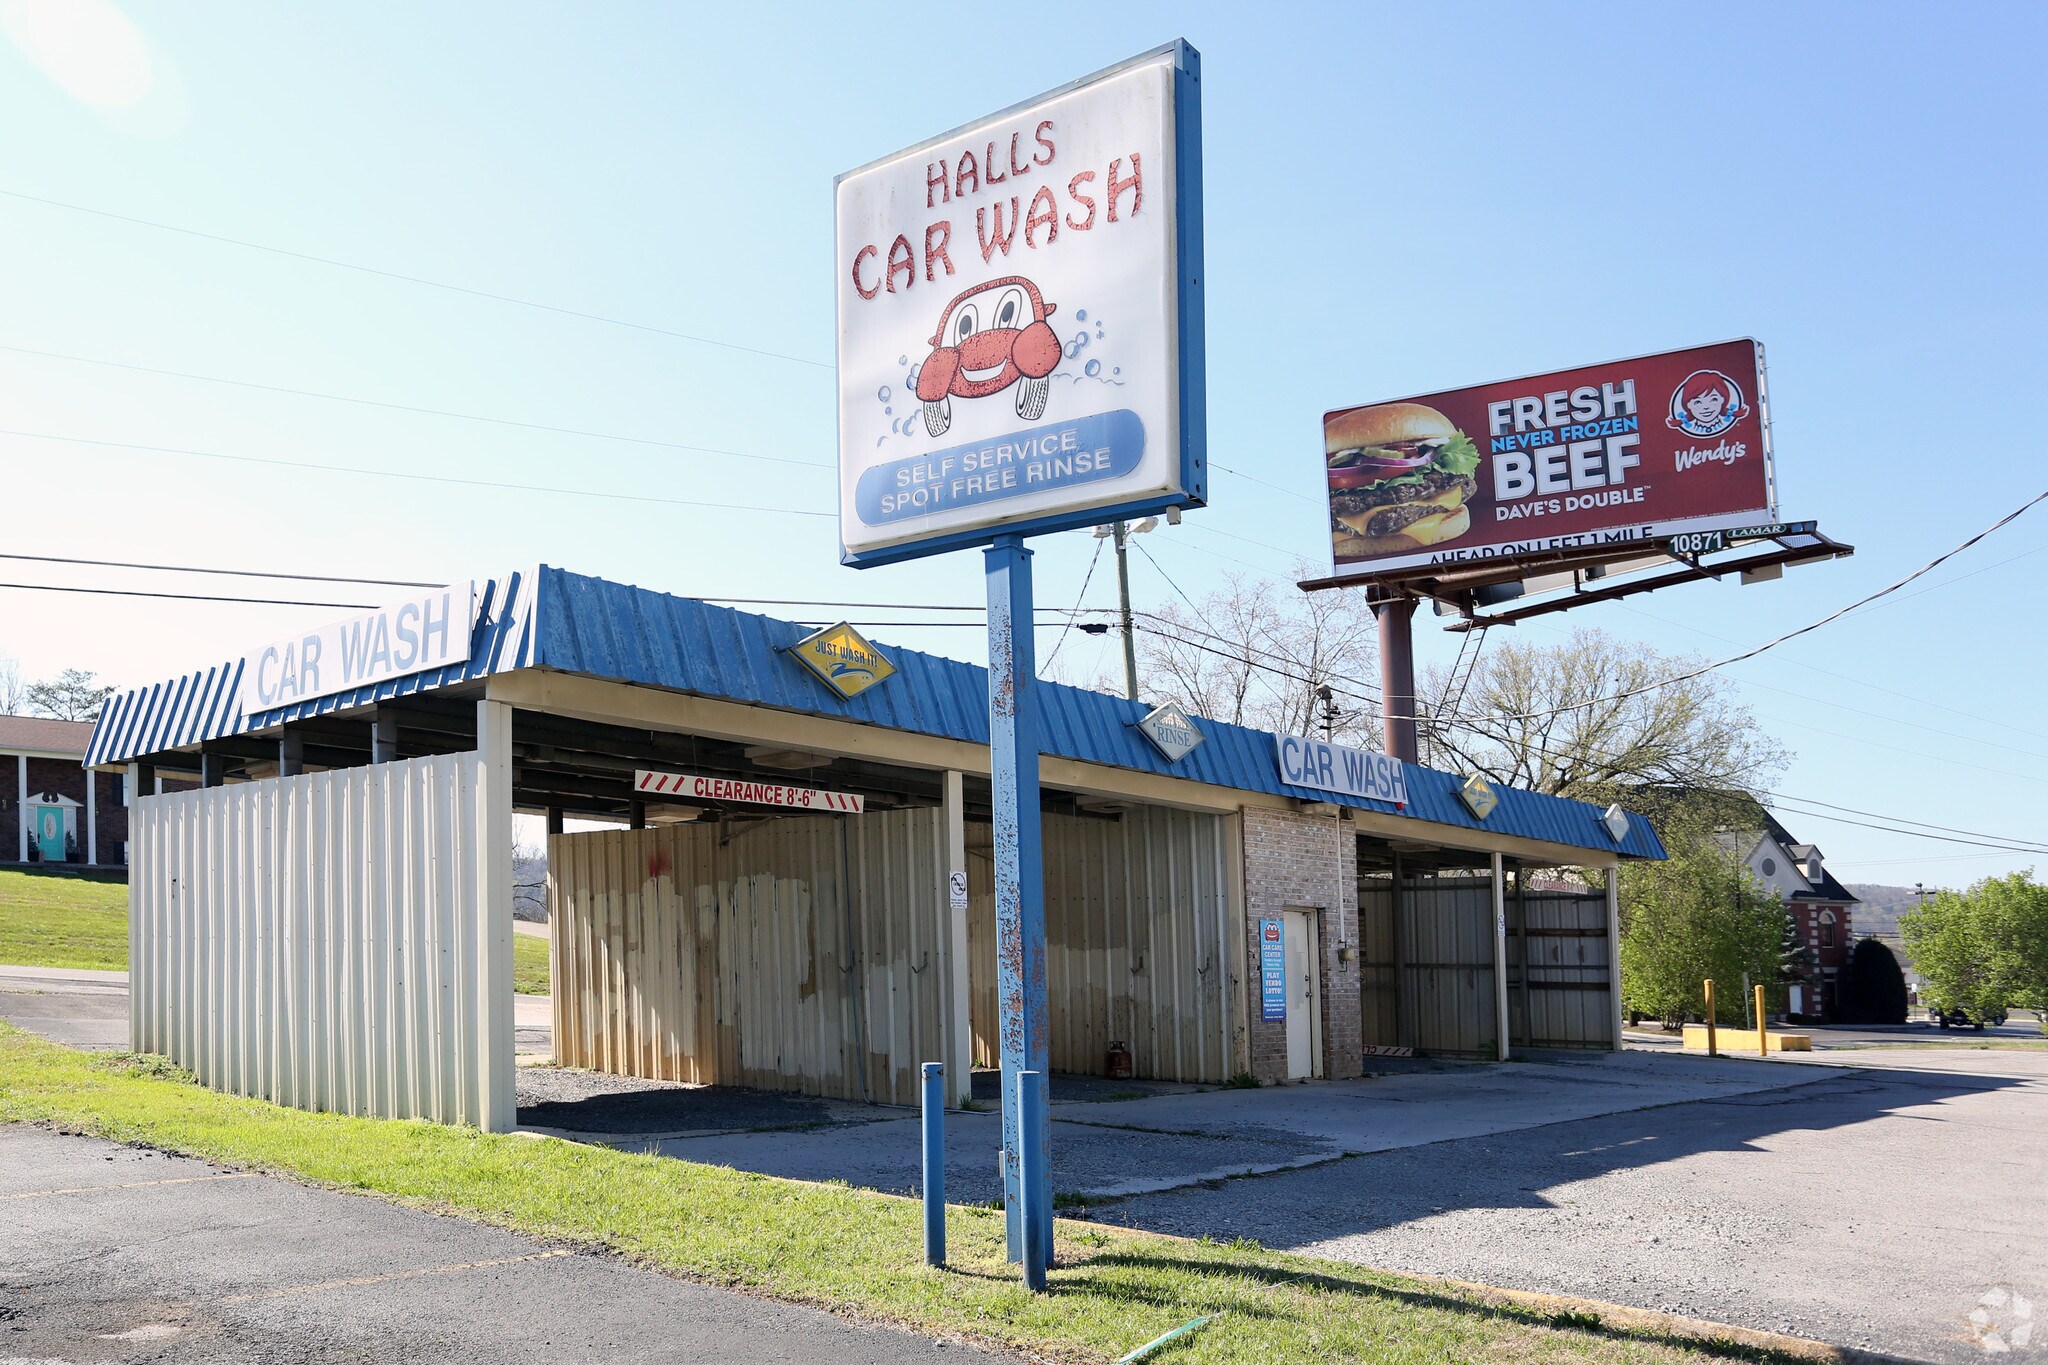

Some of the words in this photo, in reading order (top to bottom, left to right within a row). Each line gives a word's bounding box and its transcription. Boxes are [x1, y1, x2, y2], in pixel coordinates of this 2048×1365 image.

[926, 120, 1056, 208] HALLS
[852, 220, 955, 300] CAR
[976, 153, 1142, 264] WASH
[1488, 379, 1637, 436] FRESH
[1490, 426, 1555, 452] NEVER
[1560, 416, 1638, 441] FROZEN
[1674, 439, 1746, 472] Wendy's
[881, 484, 944, 514] SPOT
[953, 467, 1018, 499] FREE
[1026, 447, 1112, 483] RINSE
[896, 457, 955, 487] SELF
[963, 428, 1078, 472] SERVICE
[1492, 433, 1640, 501] BEEF
[1496, 499, 1561, 521] DAVE'S
[1732, 525, 1781, 537] LAMAR
[1670, 531, 1721, 552] 10871
[257, 634, 322, 706] CAR
[340, 593, 450, 683] WASH
[815, 640, 836, 656] JUST
[840, 646, 865, 664] WASH
[867, 653, 878, 667] IT!
[1157, 726, 1191, 747] RINSE
[1282, 737, 1335, 787] CAR
[1342, 750, 1406, 800] WASH
[694, 777, 782, 804] CLEARANCE
[787, 787, 816, 807] 8'-6"
